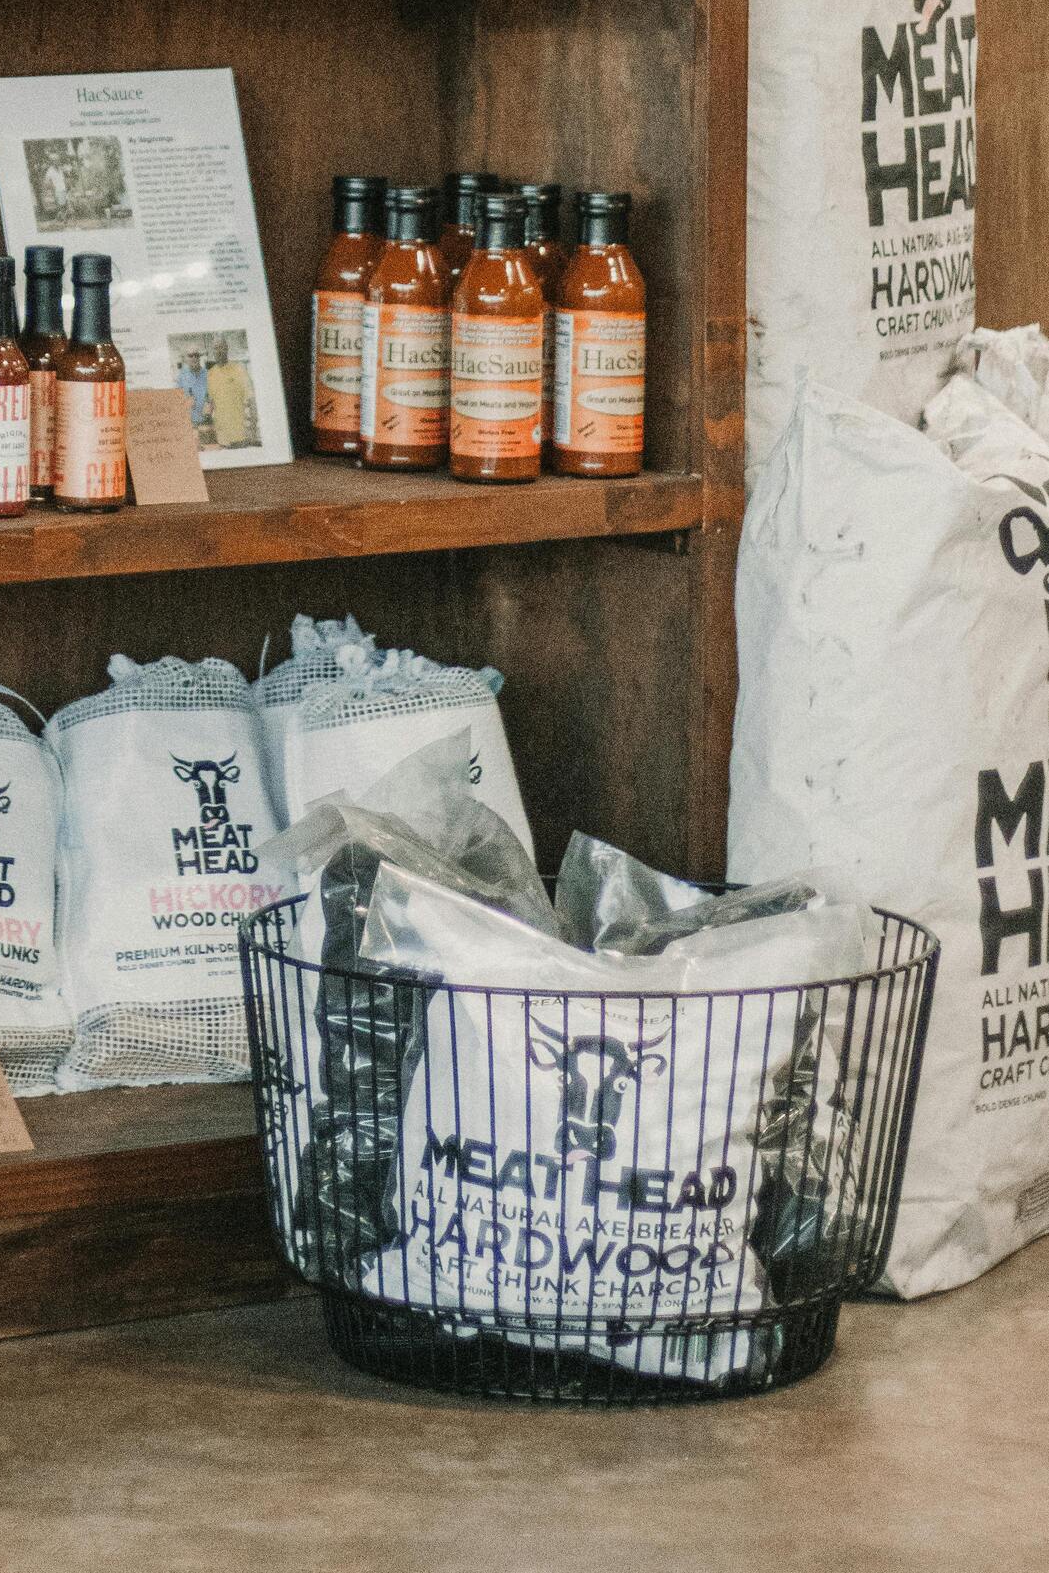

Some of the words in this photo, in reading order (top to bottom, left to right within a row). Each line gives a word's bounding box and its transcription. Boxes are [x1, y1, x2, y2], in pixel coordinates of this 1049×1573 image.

[860, 12, 976, 122] MEAT
[75, 86, 144, 104] HacSauce
[872, 239, 898, 259] ALL
[871, 250, 976, 310] HARDWO
[875, 312, 921, 337] CRAFT
[171, 824, 253, 852] MEAT
[175, 849, 259, 876] HEAD
[149, 883, 285, 913] HICKORY
[153, 912, 216, 930] WOOD
[115, 945, 180, 962] PREMIUM
[981, 988, 1013, 1010] ALL
[980, 1059, 1034, 1091] CRAFT
[975, 1099, 998, 1114] BOLD
[998, 1095, 1021, 1110] DENSE
[421, 1134, 574, 1202] MEAT
[581, 1156, 738, 1214] HEAD
[454, 1193, 563, 1229] NATURAL
[409, 1199, 735, 1276] HARDWOOD
[485, 1266, 581, 1296] CHUNK
[592, 1269, 732, 1299] CHARCOAL
